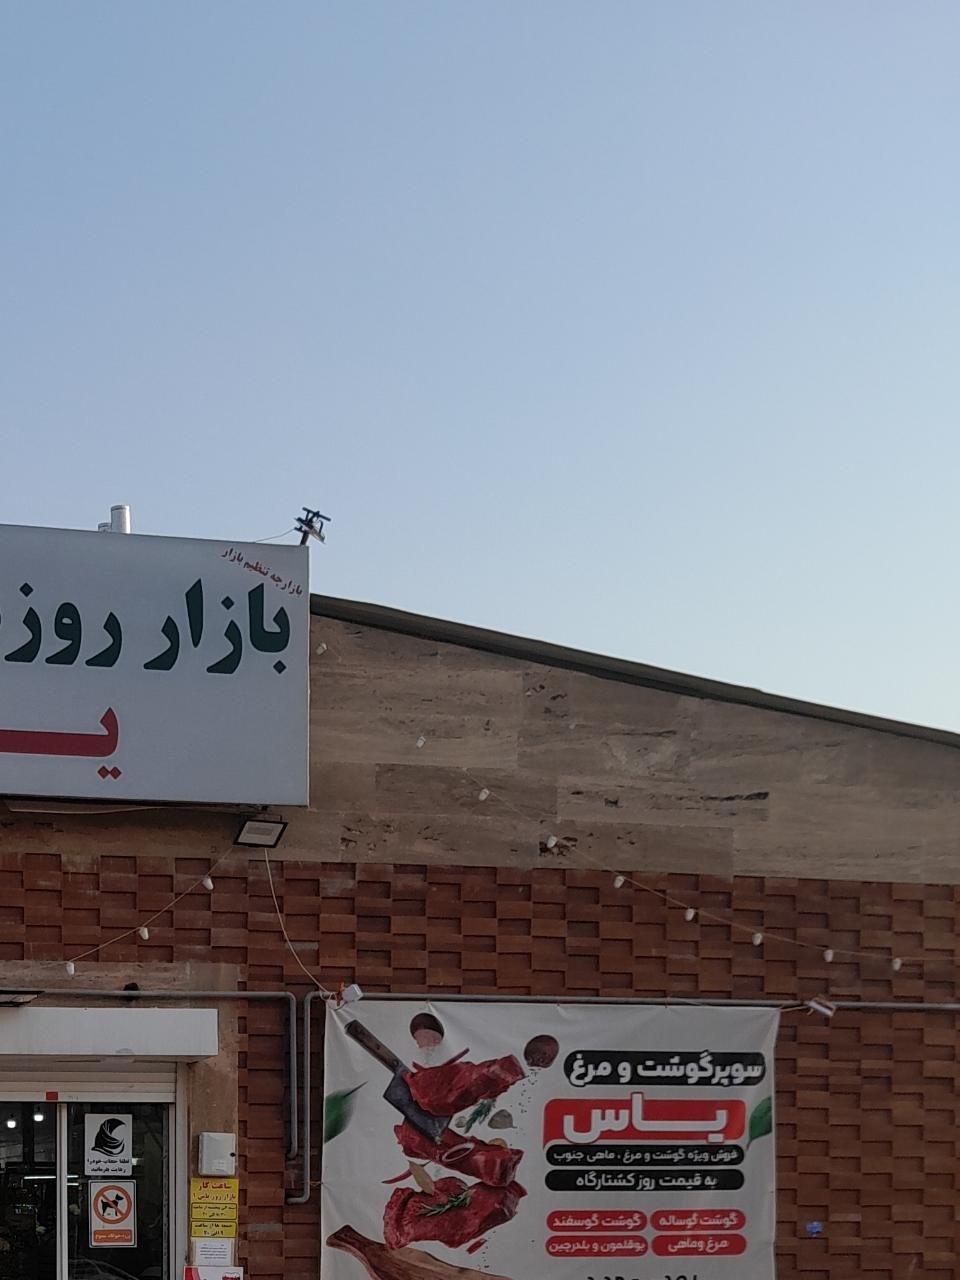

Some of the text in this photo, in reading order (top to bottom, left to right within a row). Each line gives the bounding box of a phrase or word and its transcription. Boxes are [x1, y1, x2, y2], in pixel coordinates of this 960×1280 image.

[221, 547, 244, 566] بازار
[243, 561, 269, 577] تنظیم
[3, 582, 123, 667] روز
[143, 578, 291, 674] بازار
[569, 1053, 613, 1087] مرغ
[617, 1060, 632, 1084] و
[553, 1151, 584, 1162] جنوب
[586, 1152, 616, 1164] ماهی
[644, 1154, 652, 1163] و
[652, 1149, 686, 1163] گوشت
[688, 1150, 710, 1162] ویژه
[711, 1151, 738, 1162] فروش
[199, 1181, 232, 1191] ساعت کار
[576, 1172, 718, 1190] به قیمت روز کشتارگاه
[553, 1213, 641, 1230] گوشت گوسفند
[659, 1211, 738, 1229] گوشت گوساله
[706, 1237, 730, 1253] مرغ
